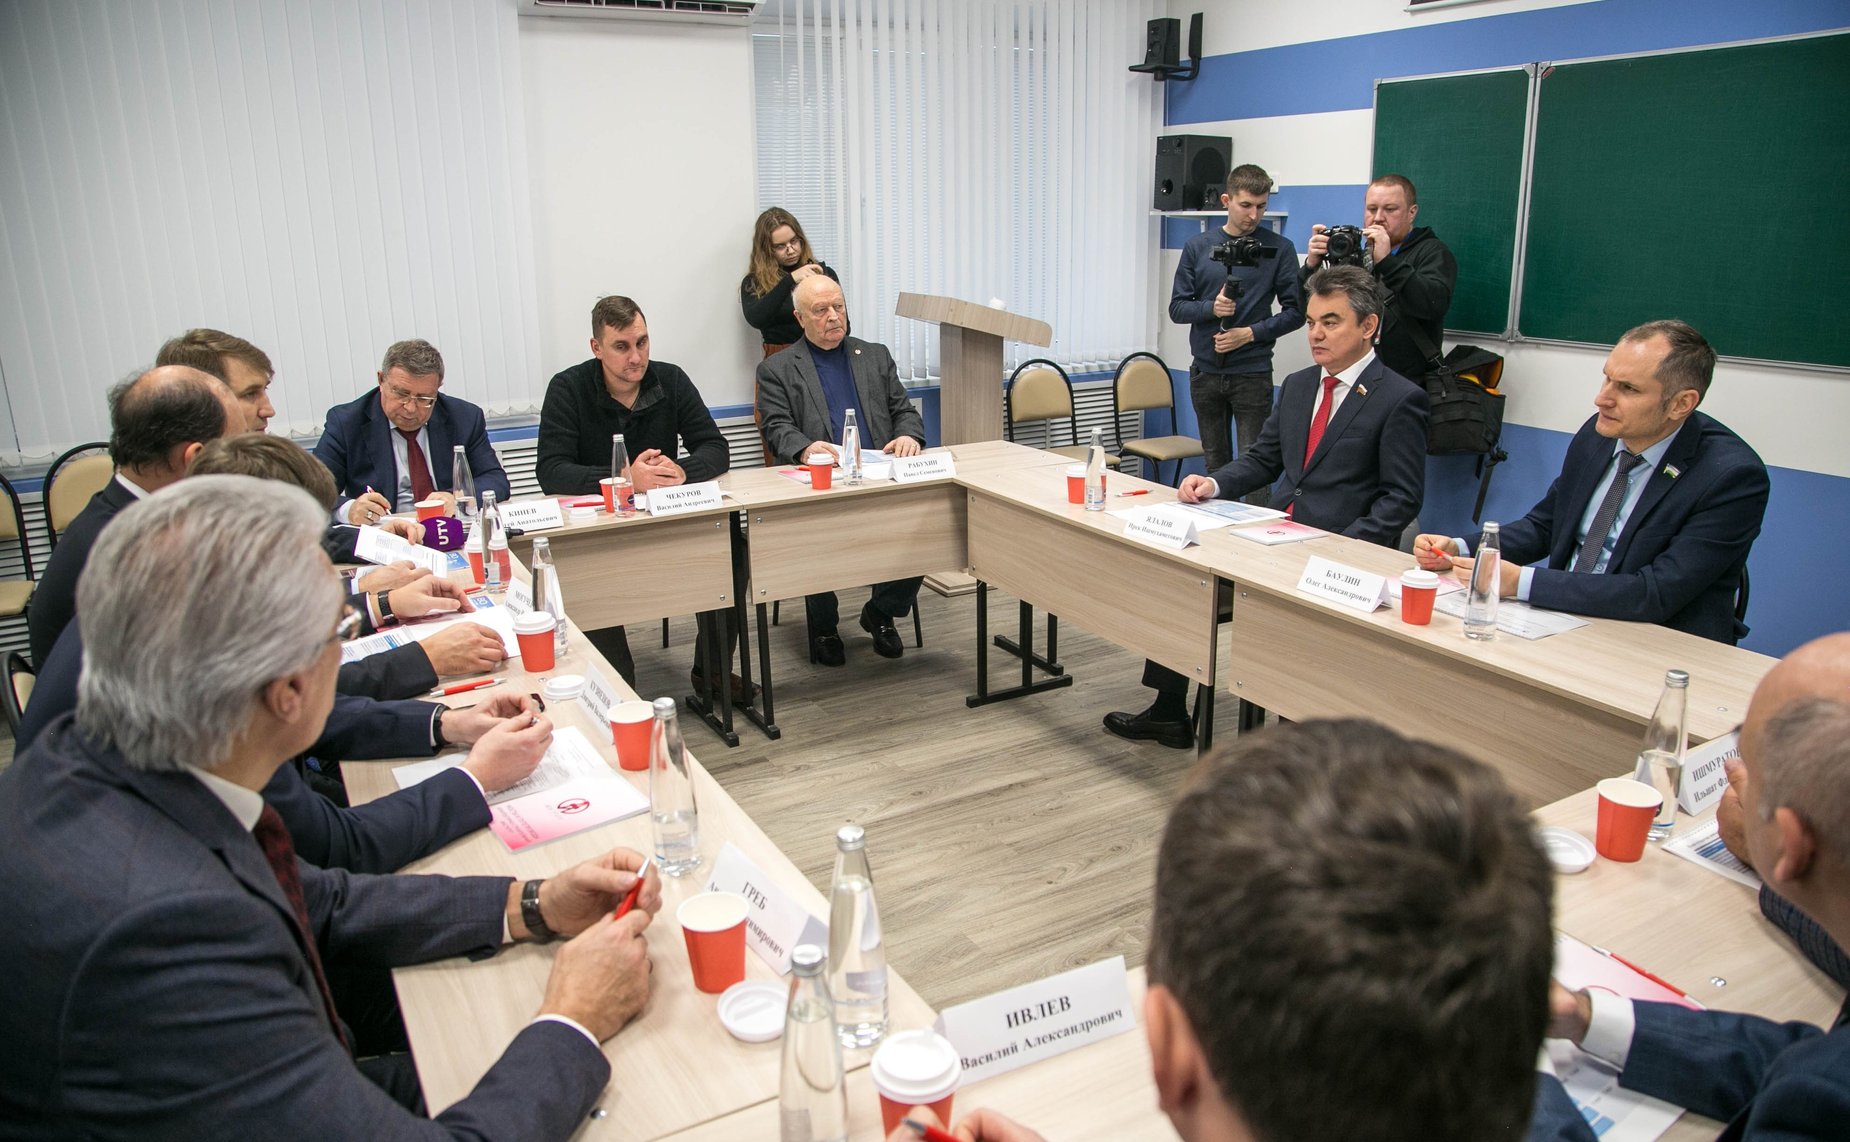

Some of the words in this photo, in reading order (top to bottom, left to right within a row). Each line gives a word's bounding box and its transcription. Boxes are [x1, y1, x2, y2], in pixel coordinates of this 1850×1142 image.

[665, 489, 702, 500] ЧЕКУРОВ
[435, 519, 450, 546] UTV
[1325, 569, 1361, 587] БАУЛИН
[742, 881, 768, 911] ГРЕБ
[1005, 995, 1072, 1030] ИВЛЕВ
[960, 1041, 1019, 1071] Василий
[1022, 1008, 1124, 1052] Александрович
